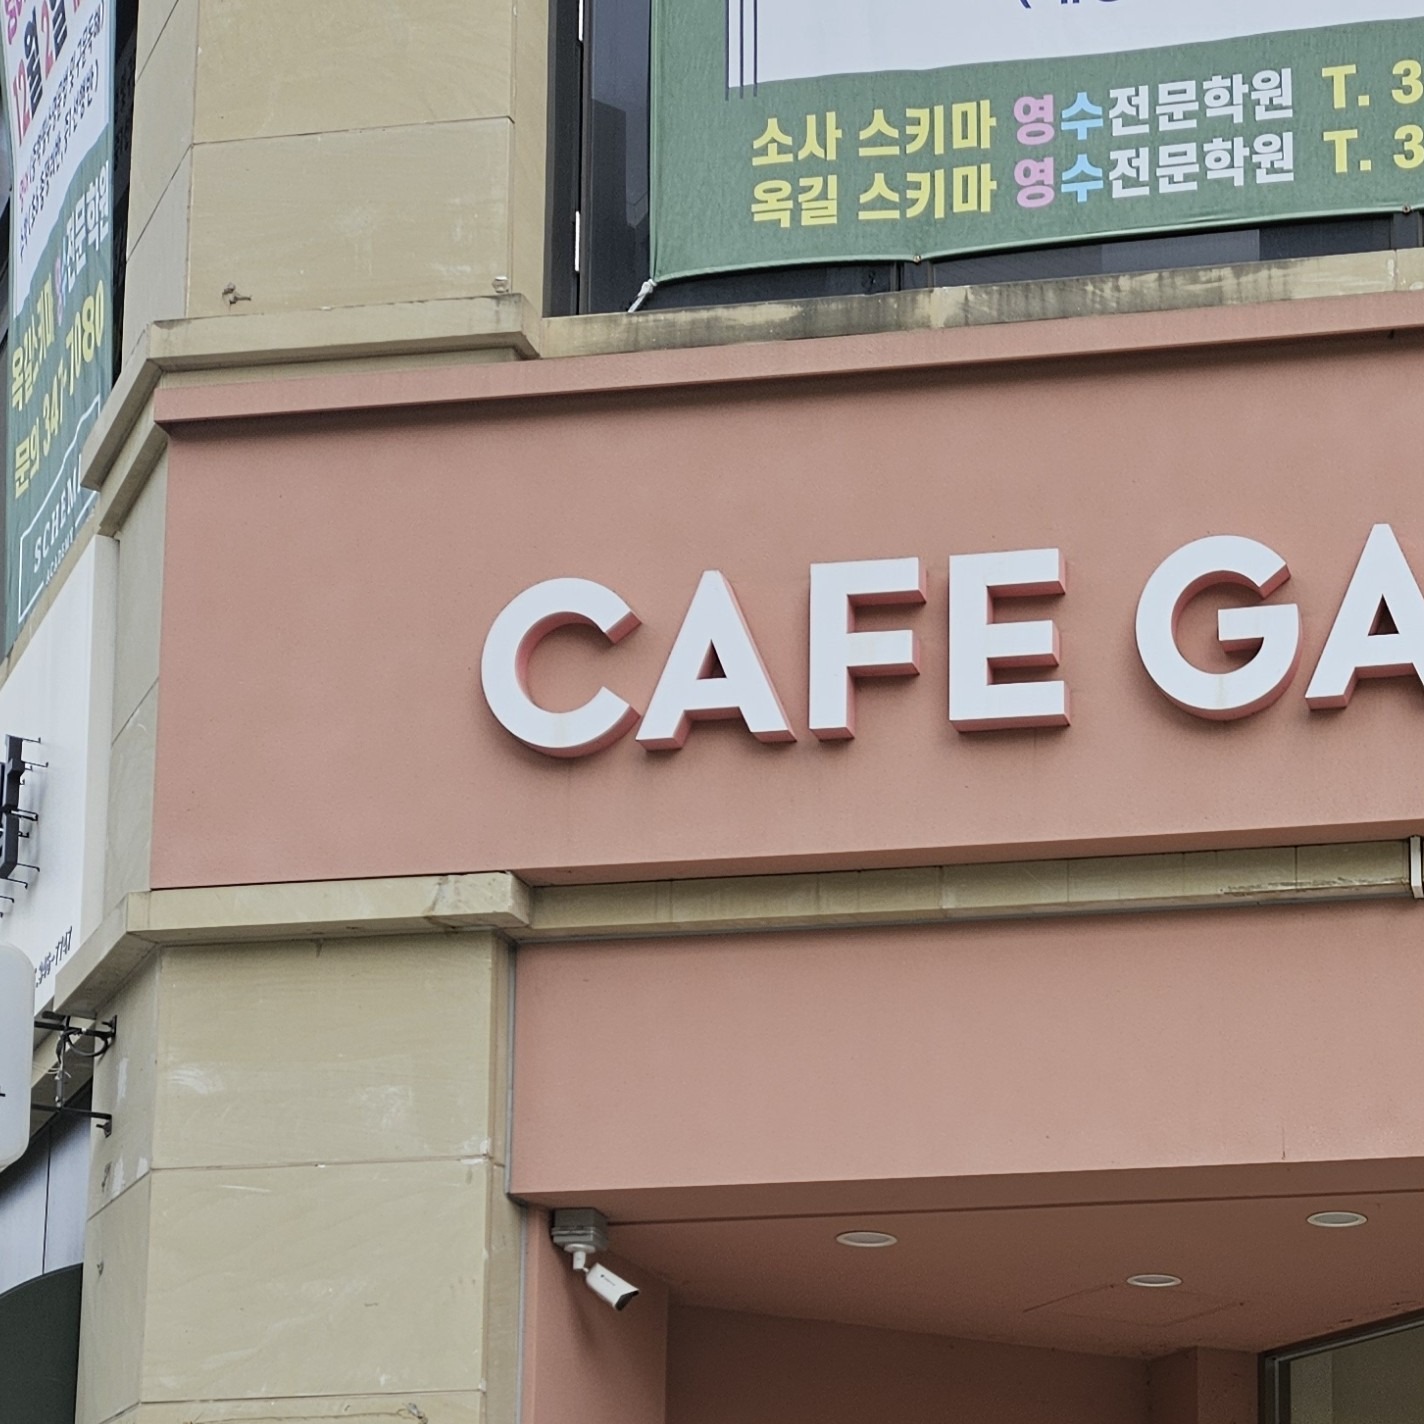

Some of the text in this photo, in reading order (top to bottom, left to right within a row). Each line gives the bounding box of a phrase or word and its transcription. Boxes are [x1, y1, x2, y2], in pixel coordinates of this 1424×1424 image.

[751, 111, 842, 166] 소사
[858, 99, 997, 158] 스키마
[1013, 67, 1294, 146] 영수전문학원
[1321, 64, 1370, 109] T.
[751, 174, 838, 228] 옥길
[858, 162, 997, 220] 스키마
[1013, 130, 1294, 209] 영수전문학원
[1323, 129, 1371, 174] T.
[12, 326, 33, 412] 옥길
[15, 417, 39, 499] 문의
[43, 279, 104, 457] 347-7080
[480, 546, 1071, 758] CAFE
